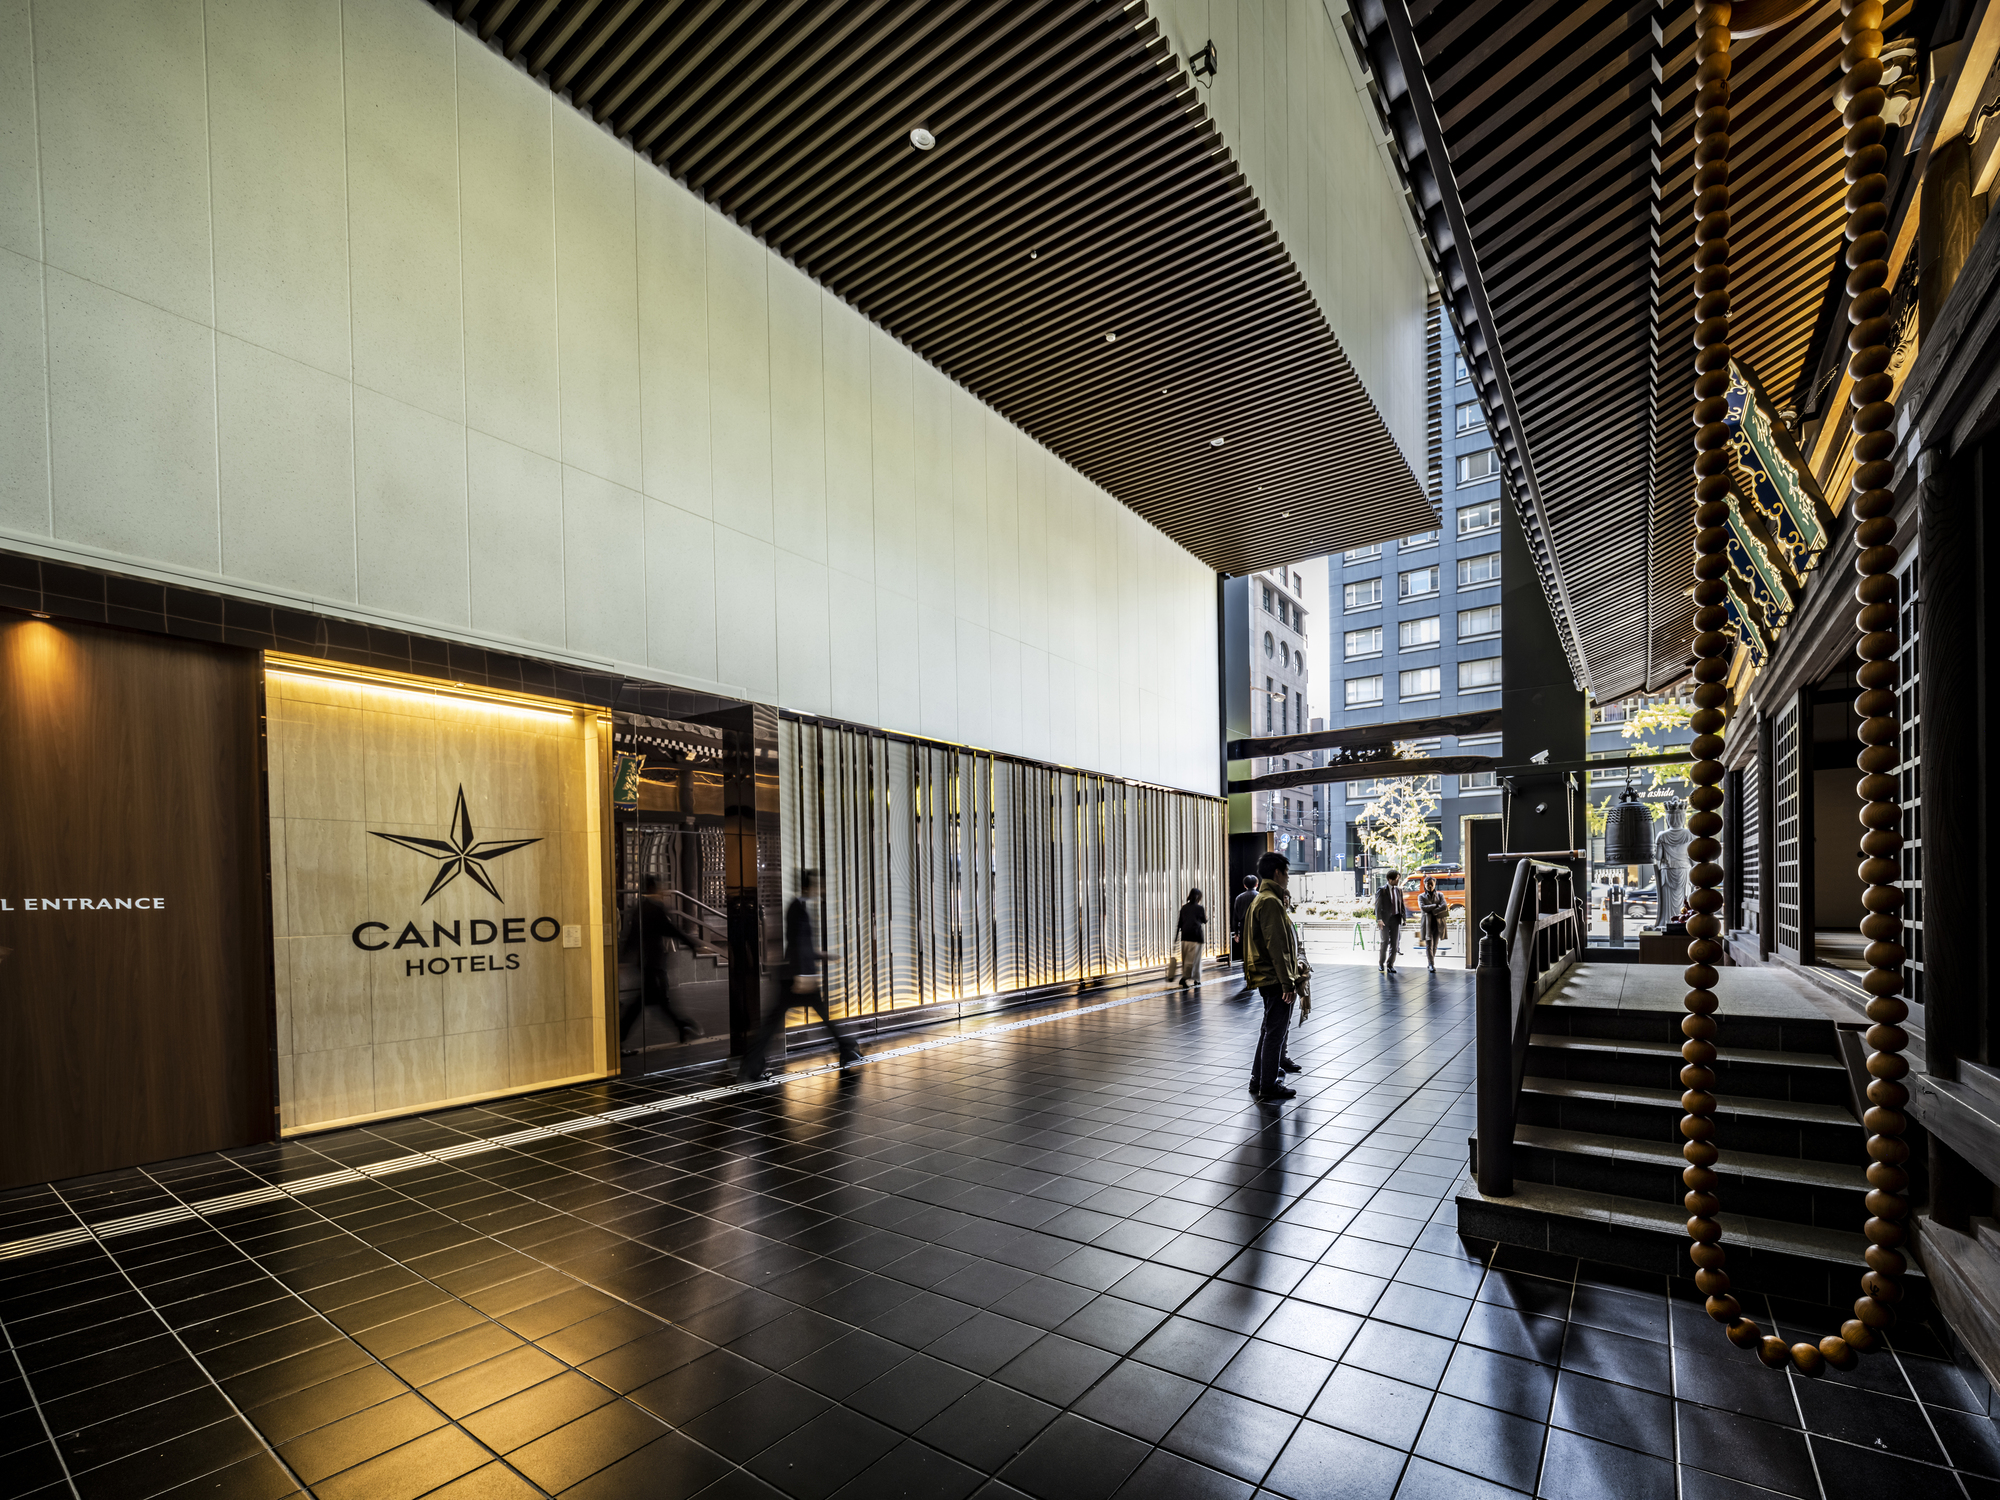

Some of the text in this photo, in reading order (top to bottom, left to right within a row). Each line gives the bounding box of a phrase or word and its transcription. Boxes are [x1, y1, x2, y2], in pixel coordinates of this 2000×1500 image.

[1647, 787, 1675, 798] ashida
[24, 898, 165, 911] ENTRANCE
[352, 916, 561, 951] CANDEO
[406, 953, 520, 977] HOTELS
